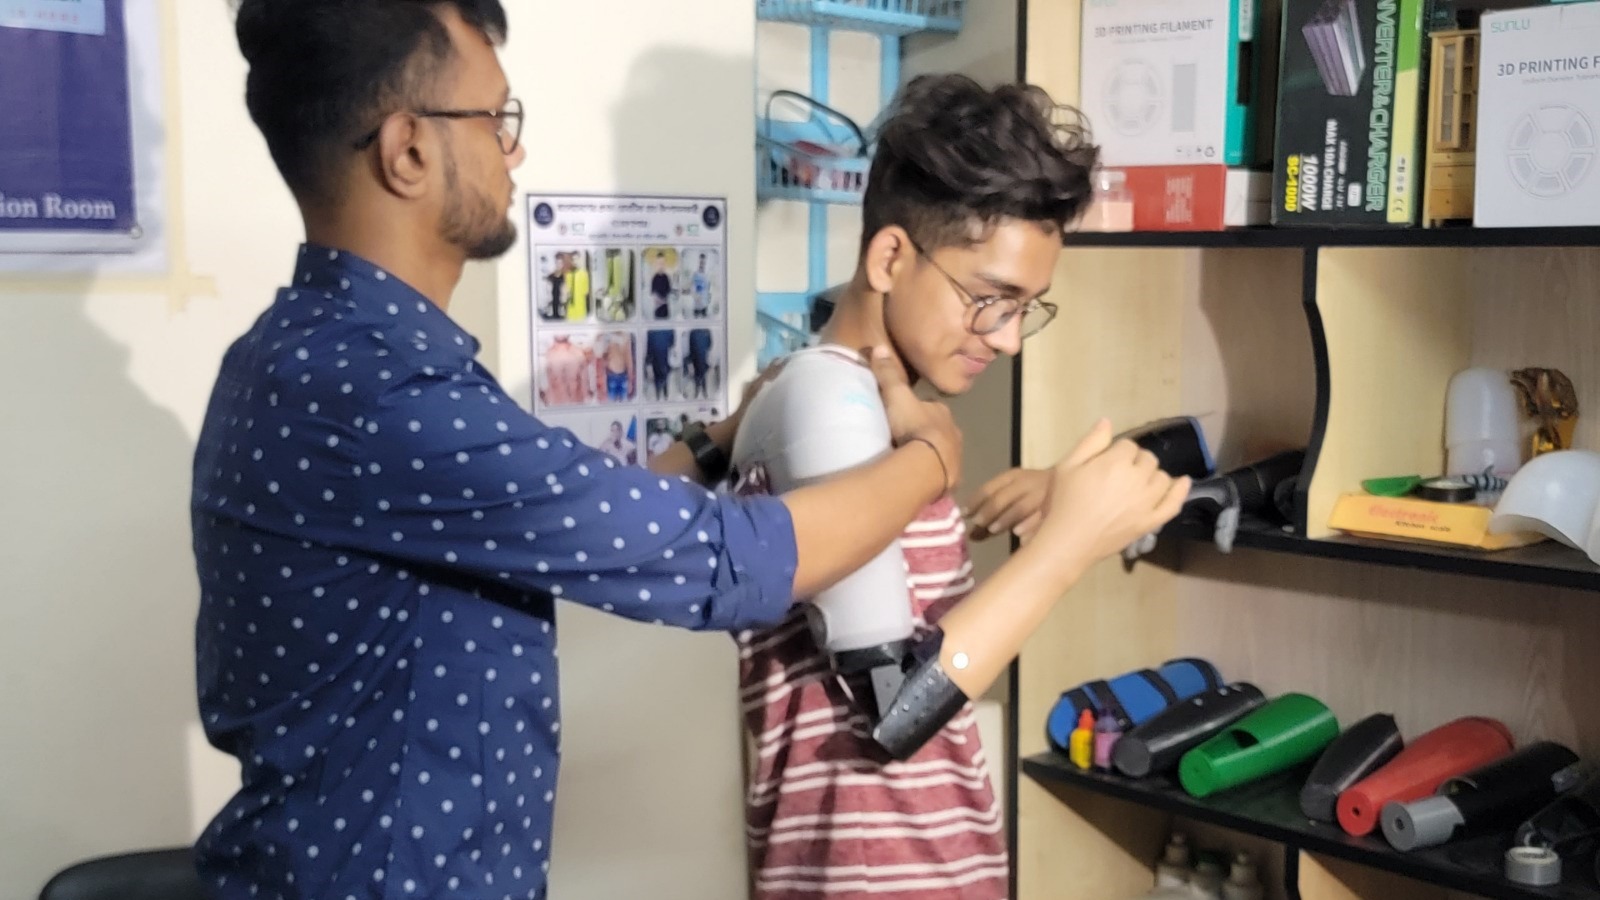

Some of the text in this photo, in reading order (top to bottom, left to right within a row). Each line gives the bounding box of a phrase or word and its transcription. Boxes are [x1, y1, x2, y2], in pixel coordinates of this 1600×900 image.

[1109, 23, 1158, 36] PRINTING
[1160, 19, 1214, 33] FILAMENT
[1497, 63, 1515, 76] 3D
[1519, 57, 1588, 75] PRINTING
[1321, 119, 1338, 211] MAX 10A CHARGE
[1301, 154, 1319, 211] 1000W
[42, 192, 116, 219] Room
